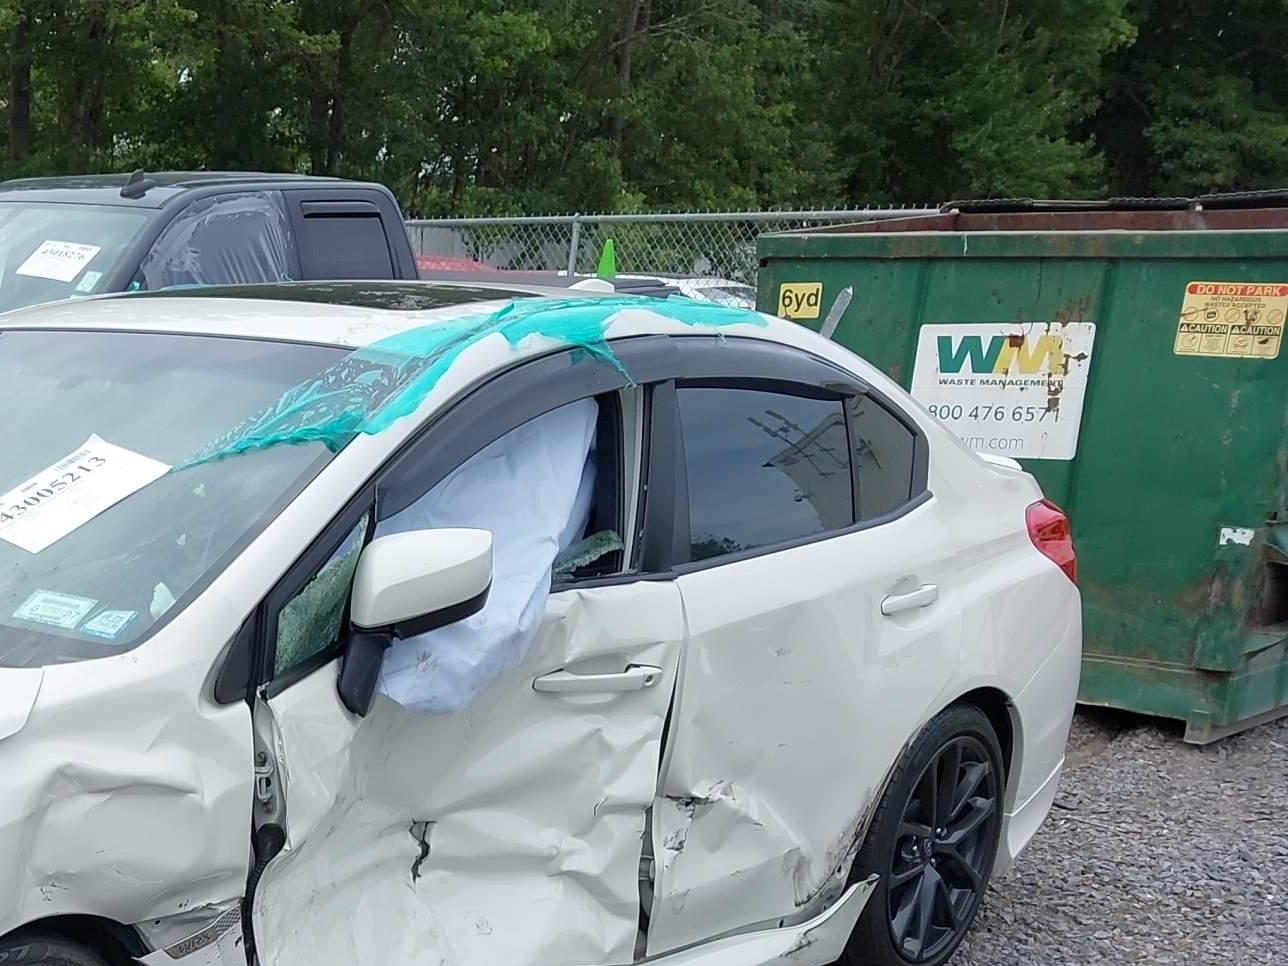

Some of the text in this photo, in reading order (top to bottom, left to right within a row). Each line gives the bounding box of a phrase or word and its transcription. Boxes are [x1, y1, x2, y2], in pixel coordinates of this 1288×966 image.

[1196, 285, 1283, 297] DO NOT PARK
[782, 287, 821, 313] 6yd
[1188, 324, 1228, 334] CAUTION
[1240, 326, 1280, 335] CAUTION
[936, 335, 1064, 374] WM
[938, 377, 1064, 388] WASTE MANAGEMENT
[969, 405, 1006, 421] 476
[1012, 406, 1060, 423] 6571
[0, 455, 107, 524] 43005213
